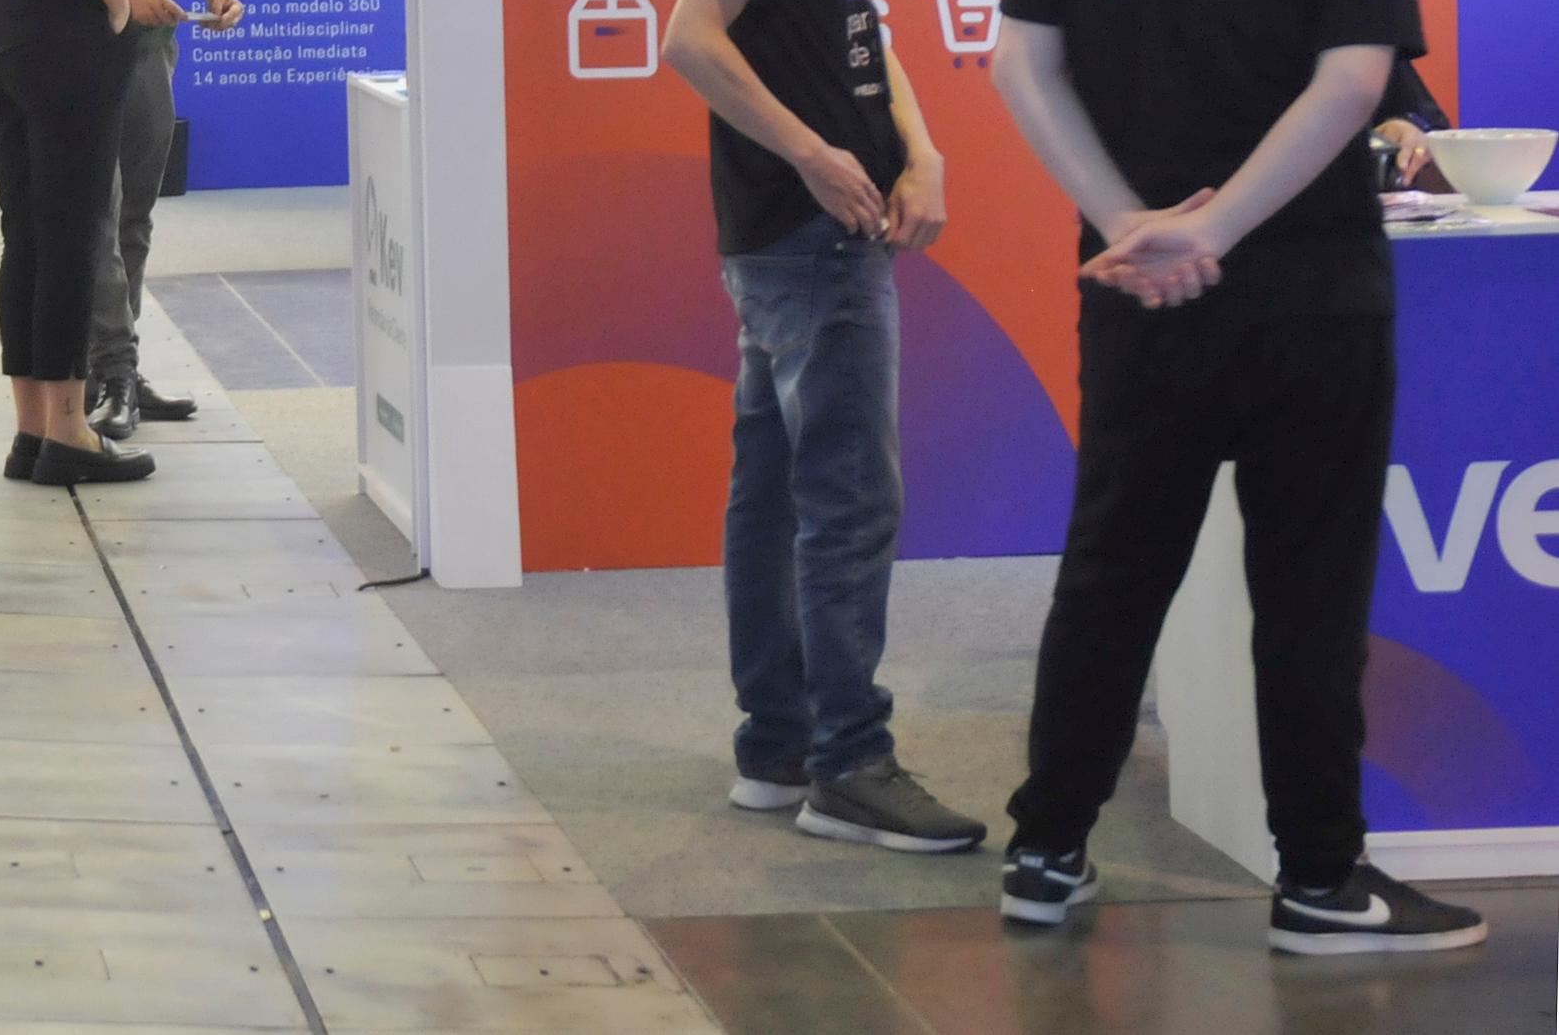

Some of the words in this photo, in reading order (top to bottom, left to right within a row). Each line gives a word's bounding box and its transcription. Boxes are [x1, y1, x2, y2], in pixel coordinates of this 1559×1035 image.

[262, 3, 281, 14] no
[286, 0, 344, 14] modelo
[250, 20, 374, 39] Multidisciplinar
[193, 47, 292, 63] Contratação
[298, 44, 367, 60] Imediata
[193, 71, 214, 85] 14
[219, 73, 257, 85] anos
[263, 70, 282, 83] de
